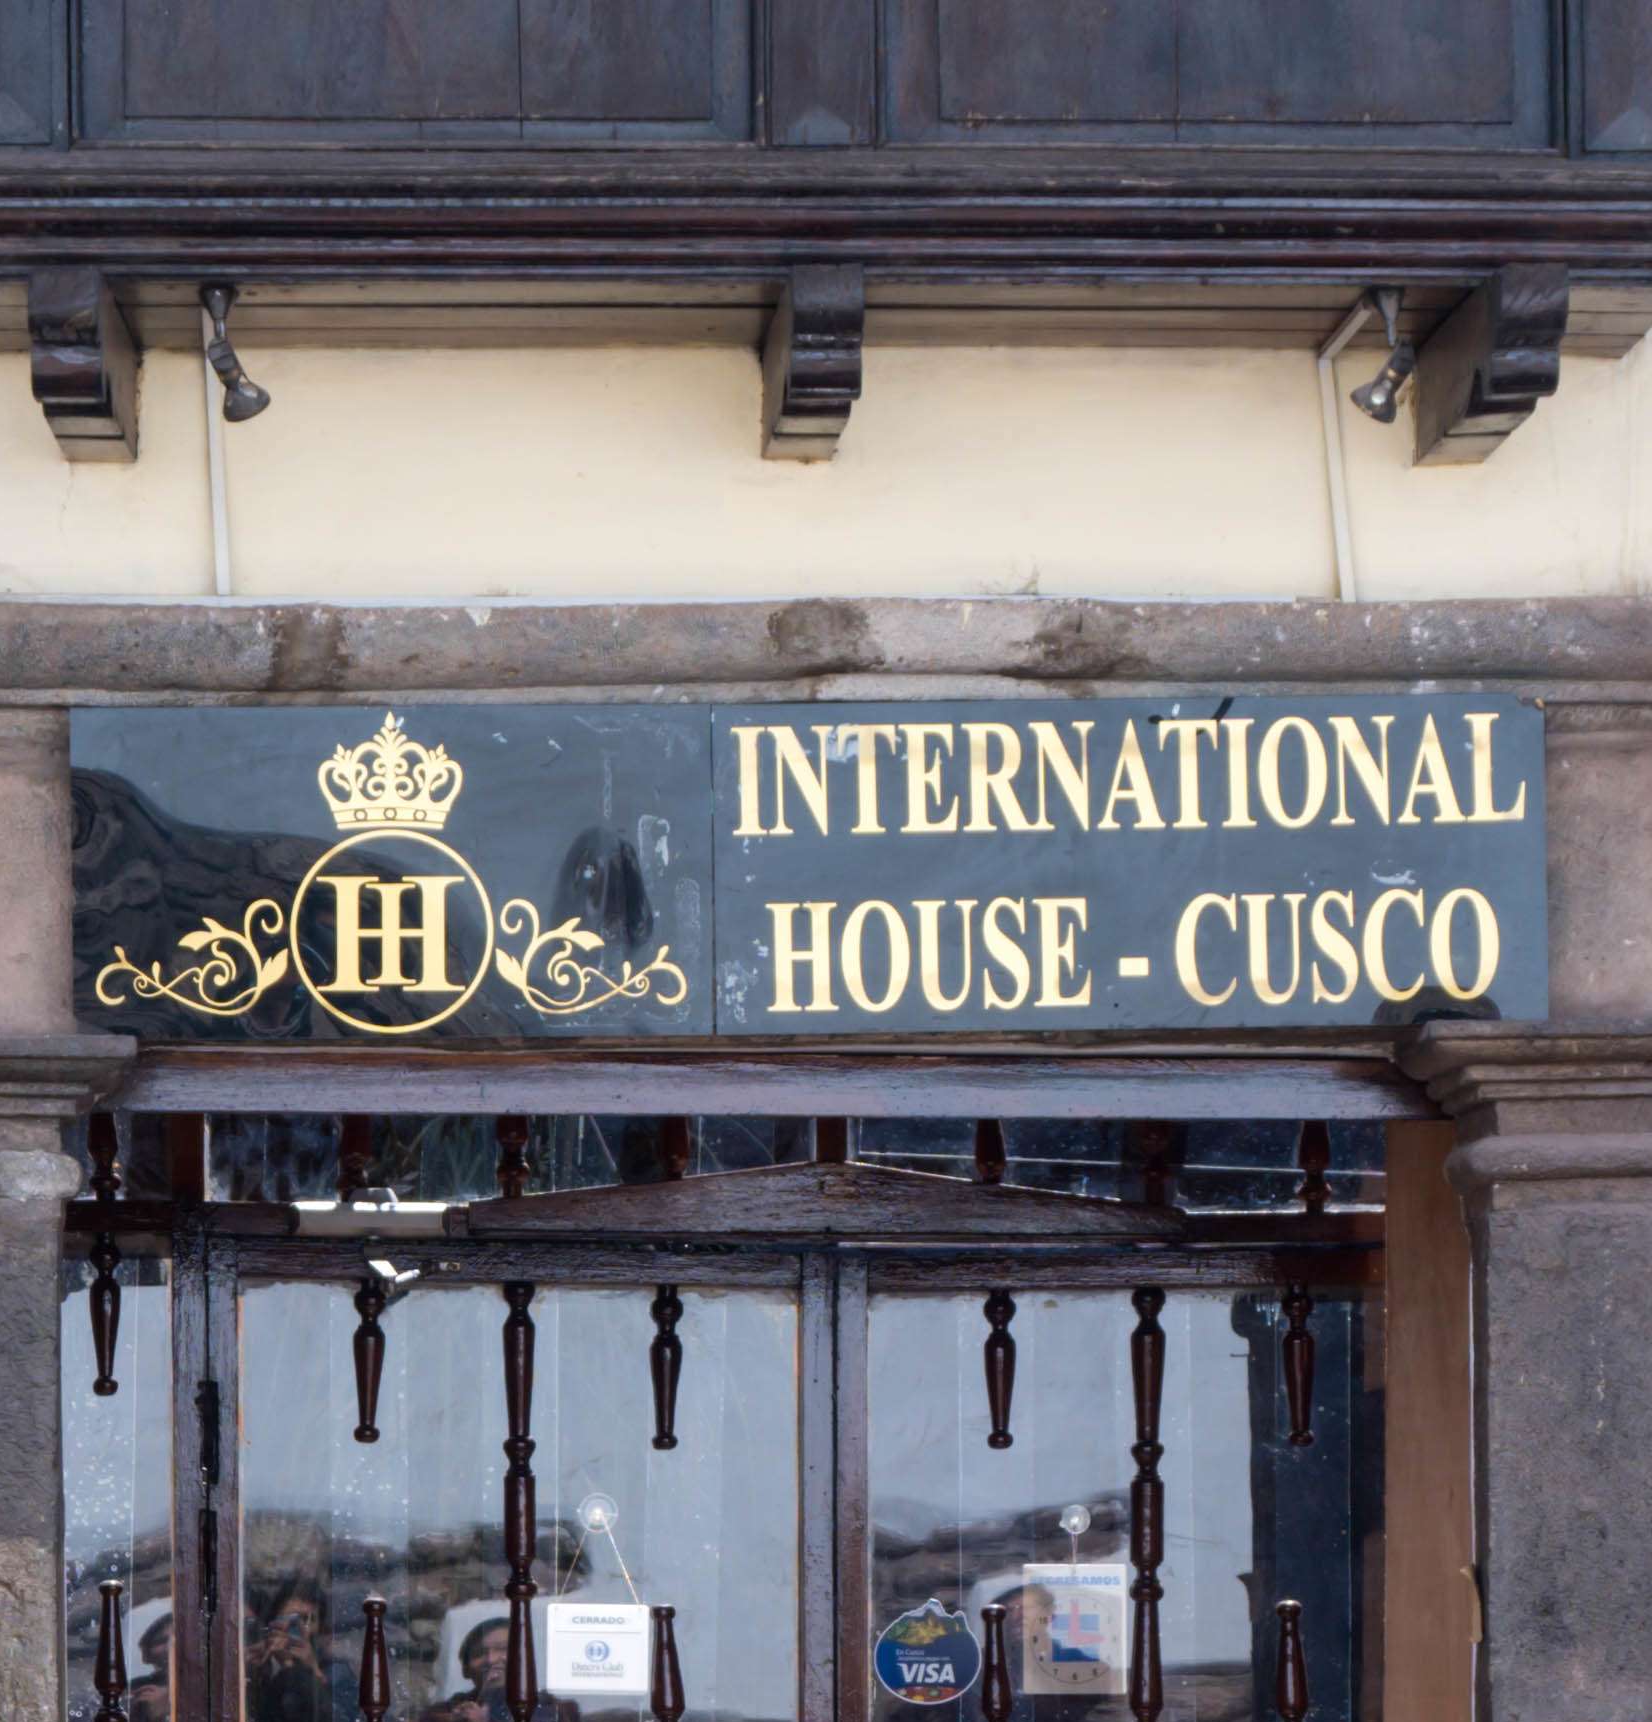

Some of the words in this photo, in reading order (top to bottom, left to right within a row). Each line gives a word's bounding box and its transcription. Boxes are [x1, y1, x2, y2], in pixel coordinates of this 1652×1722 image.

[730, 713, 1526, 836] INTERNATIONAL
[765, 897, 1092, 1013] HOUSE
[1174, 887, 1500, 1006] CUSCO
[571, 1616, 626, 1625] CERRADO
[896, 1662, 956, 1684] VISA
